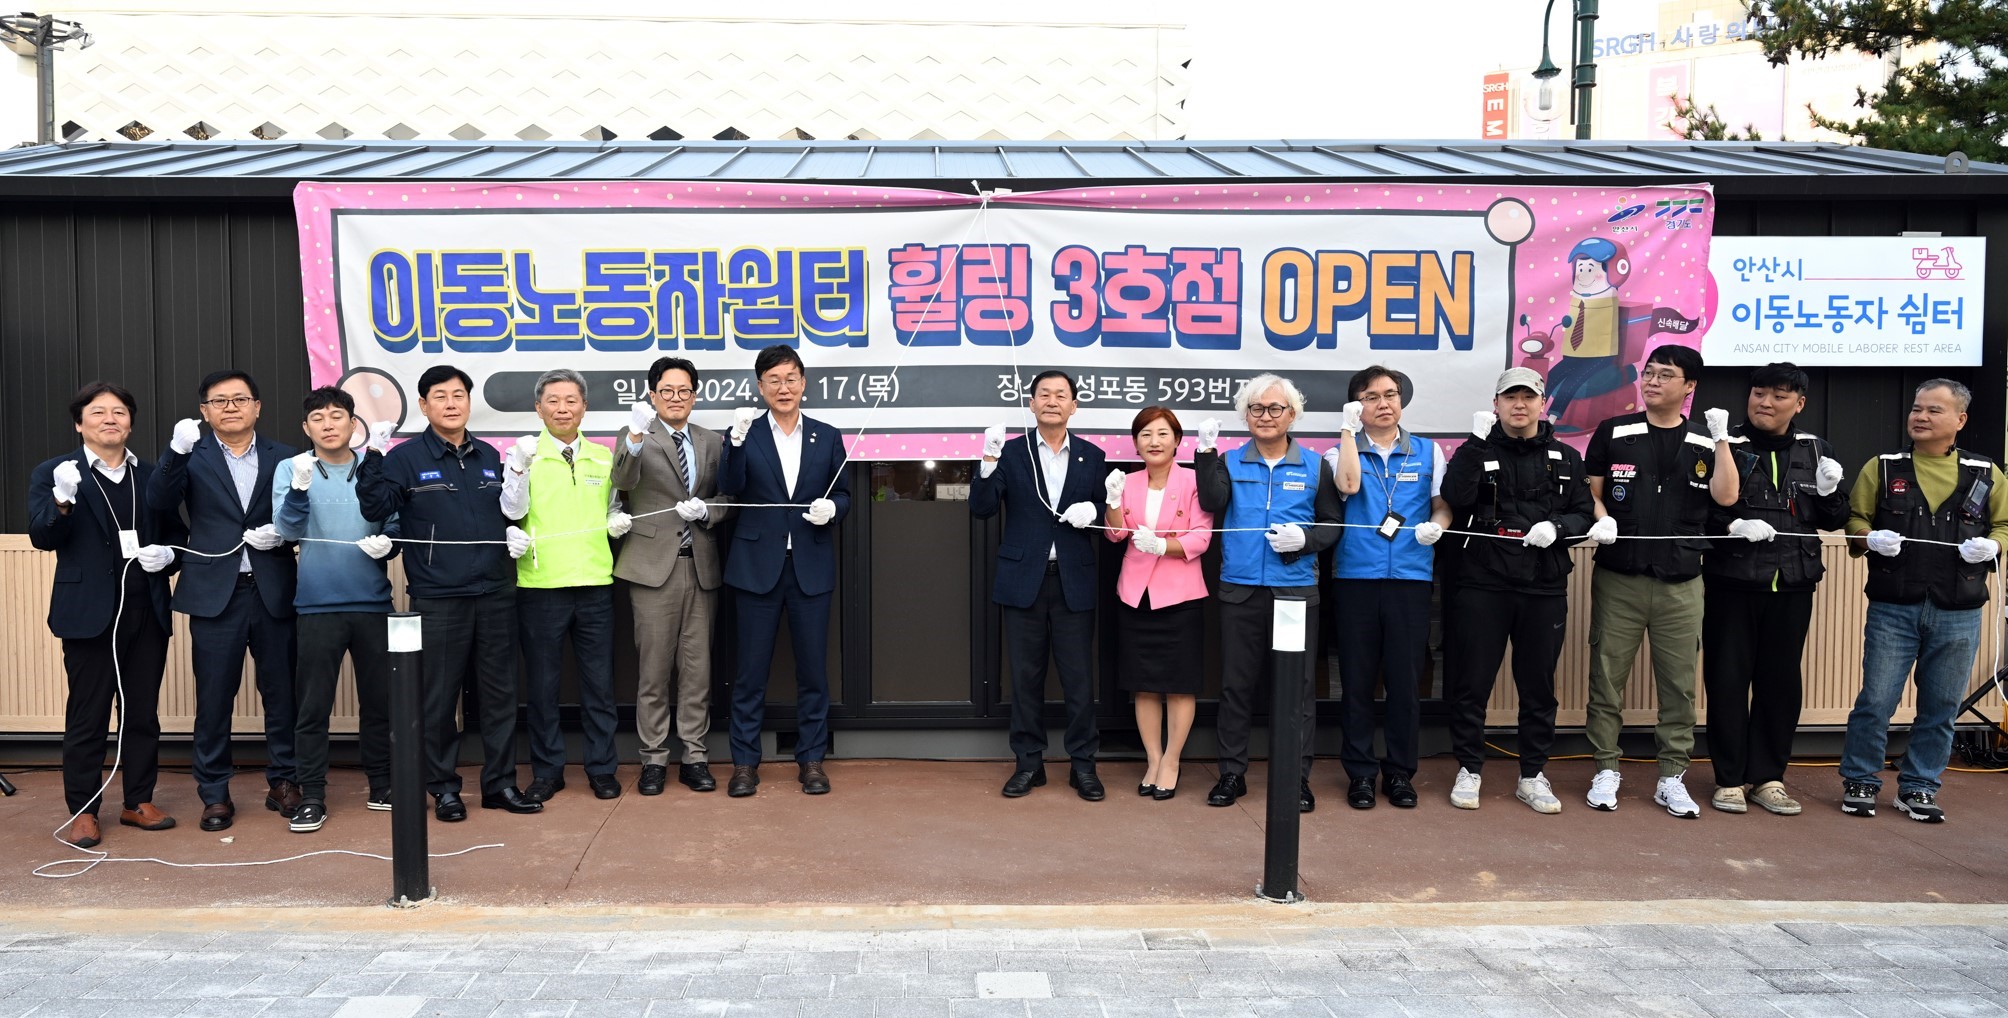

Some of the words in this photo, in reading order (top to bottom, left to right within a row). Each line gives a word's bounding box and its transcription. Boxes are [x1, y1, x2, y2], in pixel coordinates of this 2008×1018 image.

[1593, 32, 1656, 58] SRGH
[1483, 82, 1509, 92] SRGH
[1665, 219, 1692, 230] 경기도
[1733, 256, 1802, 283] 안산시
[368, 246, 872, 353] 이동노동자쉼터
[888, 243, 1033, 347] 휠링
[1050, 244, 1243, 350] 3호점
[1261, 247, 1476, 352] OPEN
[1657, 317, 1689, 331] 신속배달
[1732, 295, 1888, 334] 이동노동자
[1897, 293, 1963, 335] 쉼터
[1734, 343, 1770, 354] ANSAN
[1773, 343, 1799, 354] CITY
[1802, 343, 1844, 354] MOBILE
[1848, 343, 1899, 354] LABORER
[1903, 343, 1930, 354] REST
[1933, 343, 1962, 354] AREA
[818, 373, 900, 402] 17.(목)
[1076, 374, 1148, 402] 성포동
